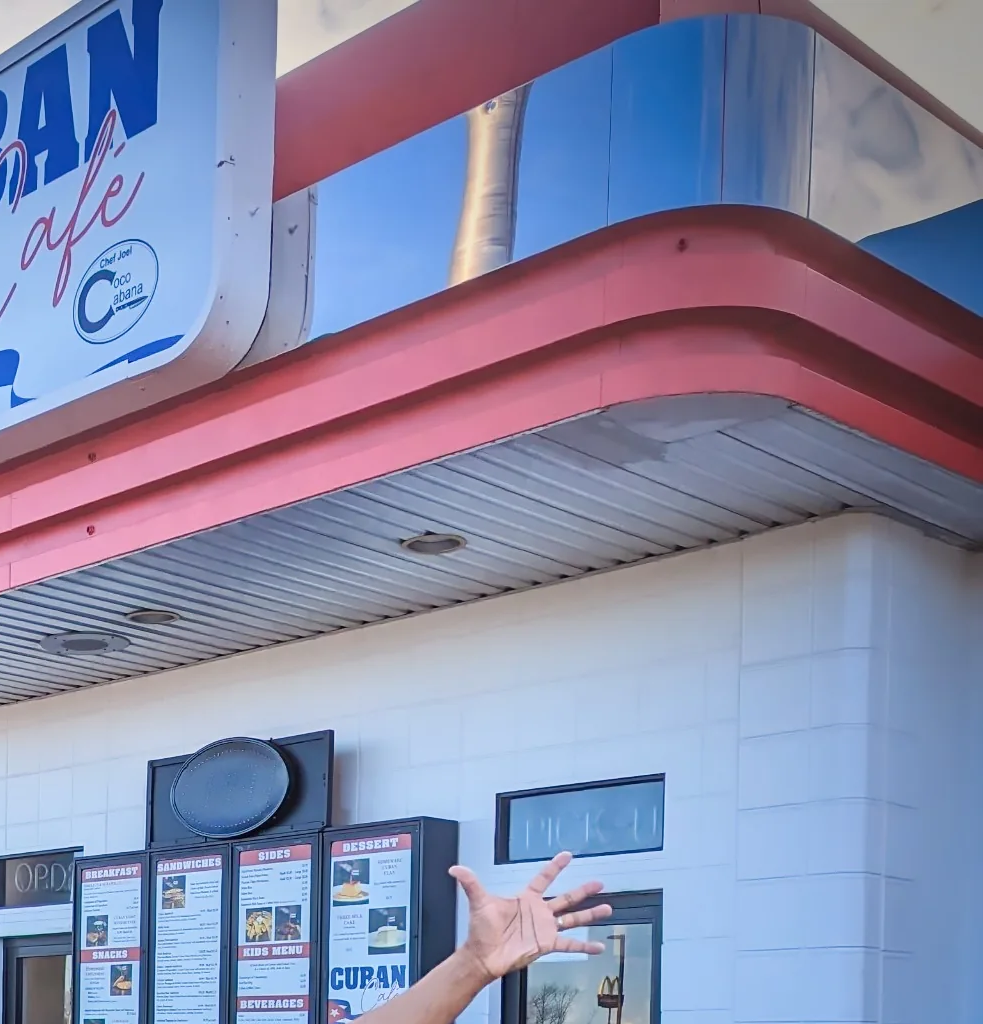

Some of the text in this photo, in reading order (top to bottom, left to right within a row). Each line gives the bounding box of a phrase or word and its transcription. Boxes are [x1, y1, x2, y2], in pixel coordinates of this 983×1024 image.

[99, 245, 133, 269] Chef Joel
[342, 838, 399, 852] DESSERT
[258, 849, 291, 861] SIDES
[157, 857, 222, 871] SANDWICHES
[85, 867, 139, 880] BREAKFAST
[92, 950, 128, 960] SNACKS
[243, 945, 304, 957] KIDS MENU
[331, 965, 407, 991] CUBAN
[240, 999, 304, 1009] BEVERAGES
